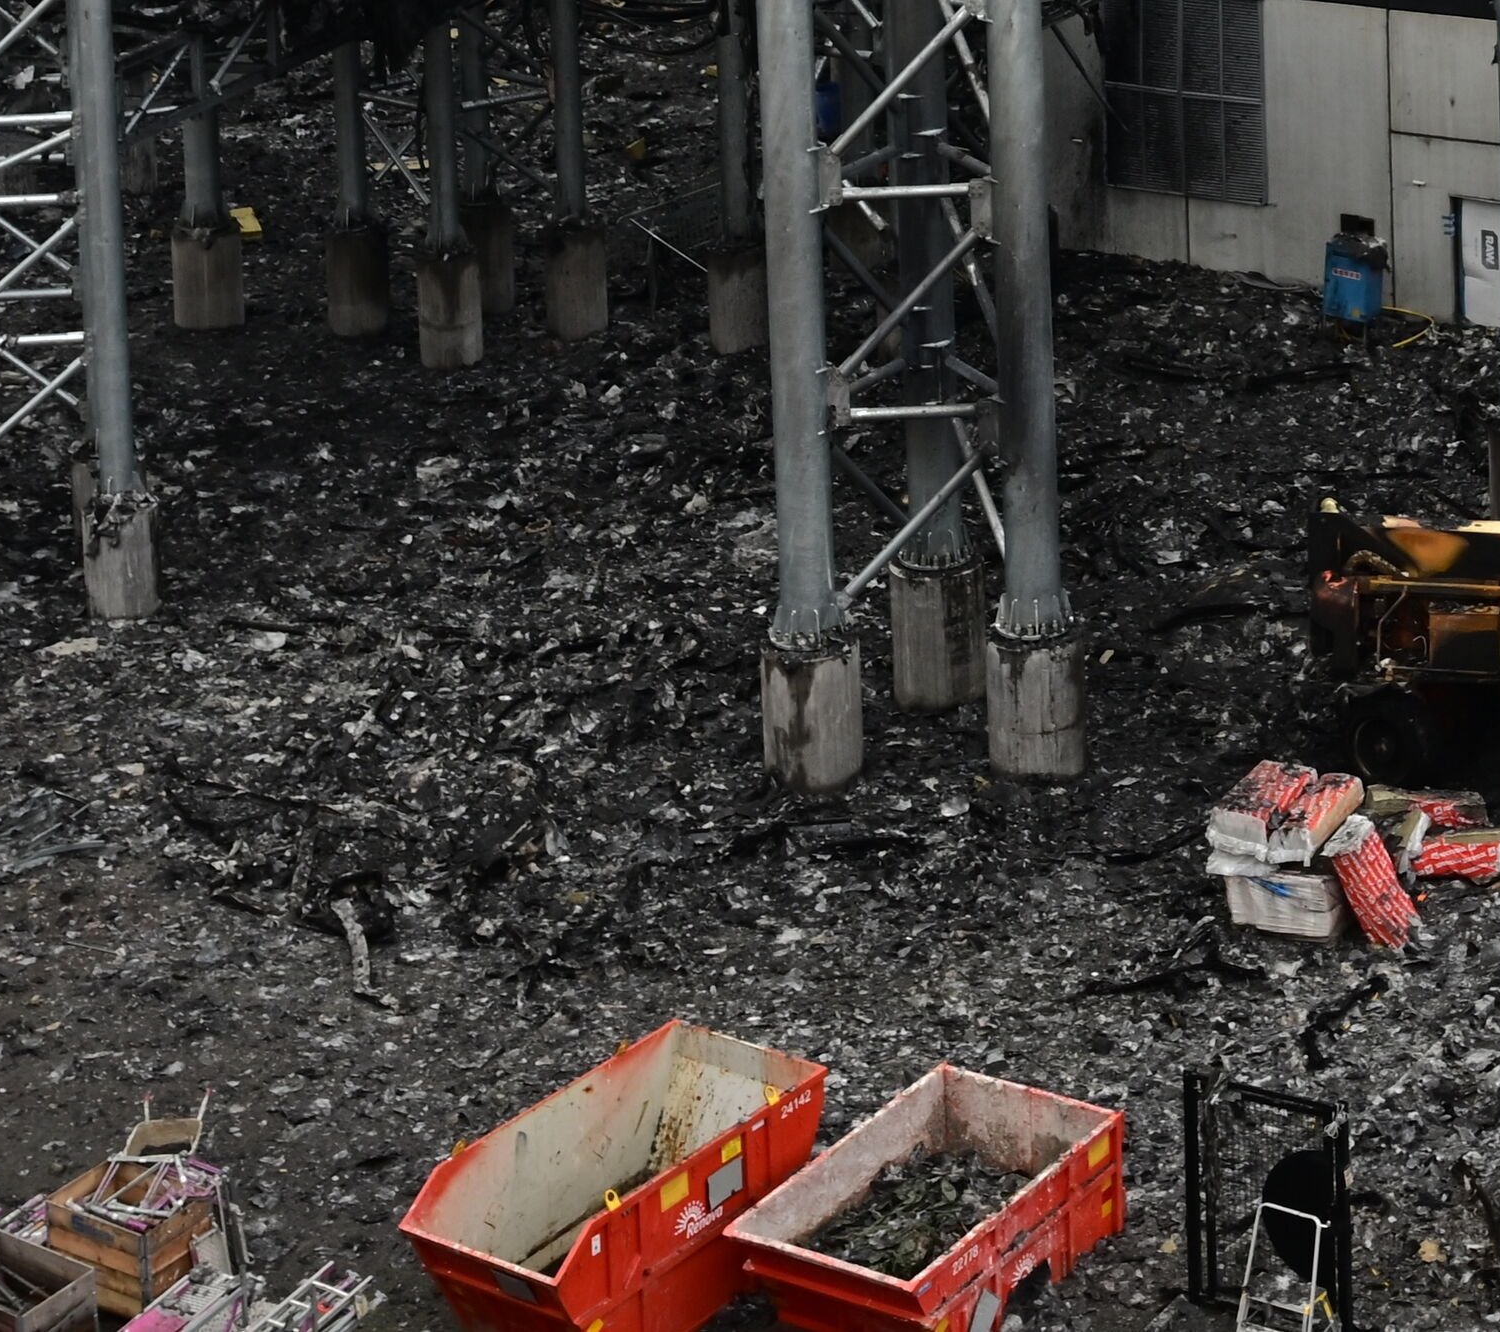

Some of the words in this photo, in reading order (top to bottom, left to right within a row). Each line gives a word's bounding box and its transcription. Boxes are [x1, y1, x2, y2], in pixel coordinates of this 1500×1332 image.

[1484, 235, 1495, 265] RAW
[780, 1089, 812, 1120] 24142
[686, 1204, 724, 1239] Renova
